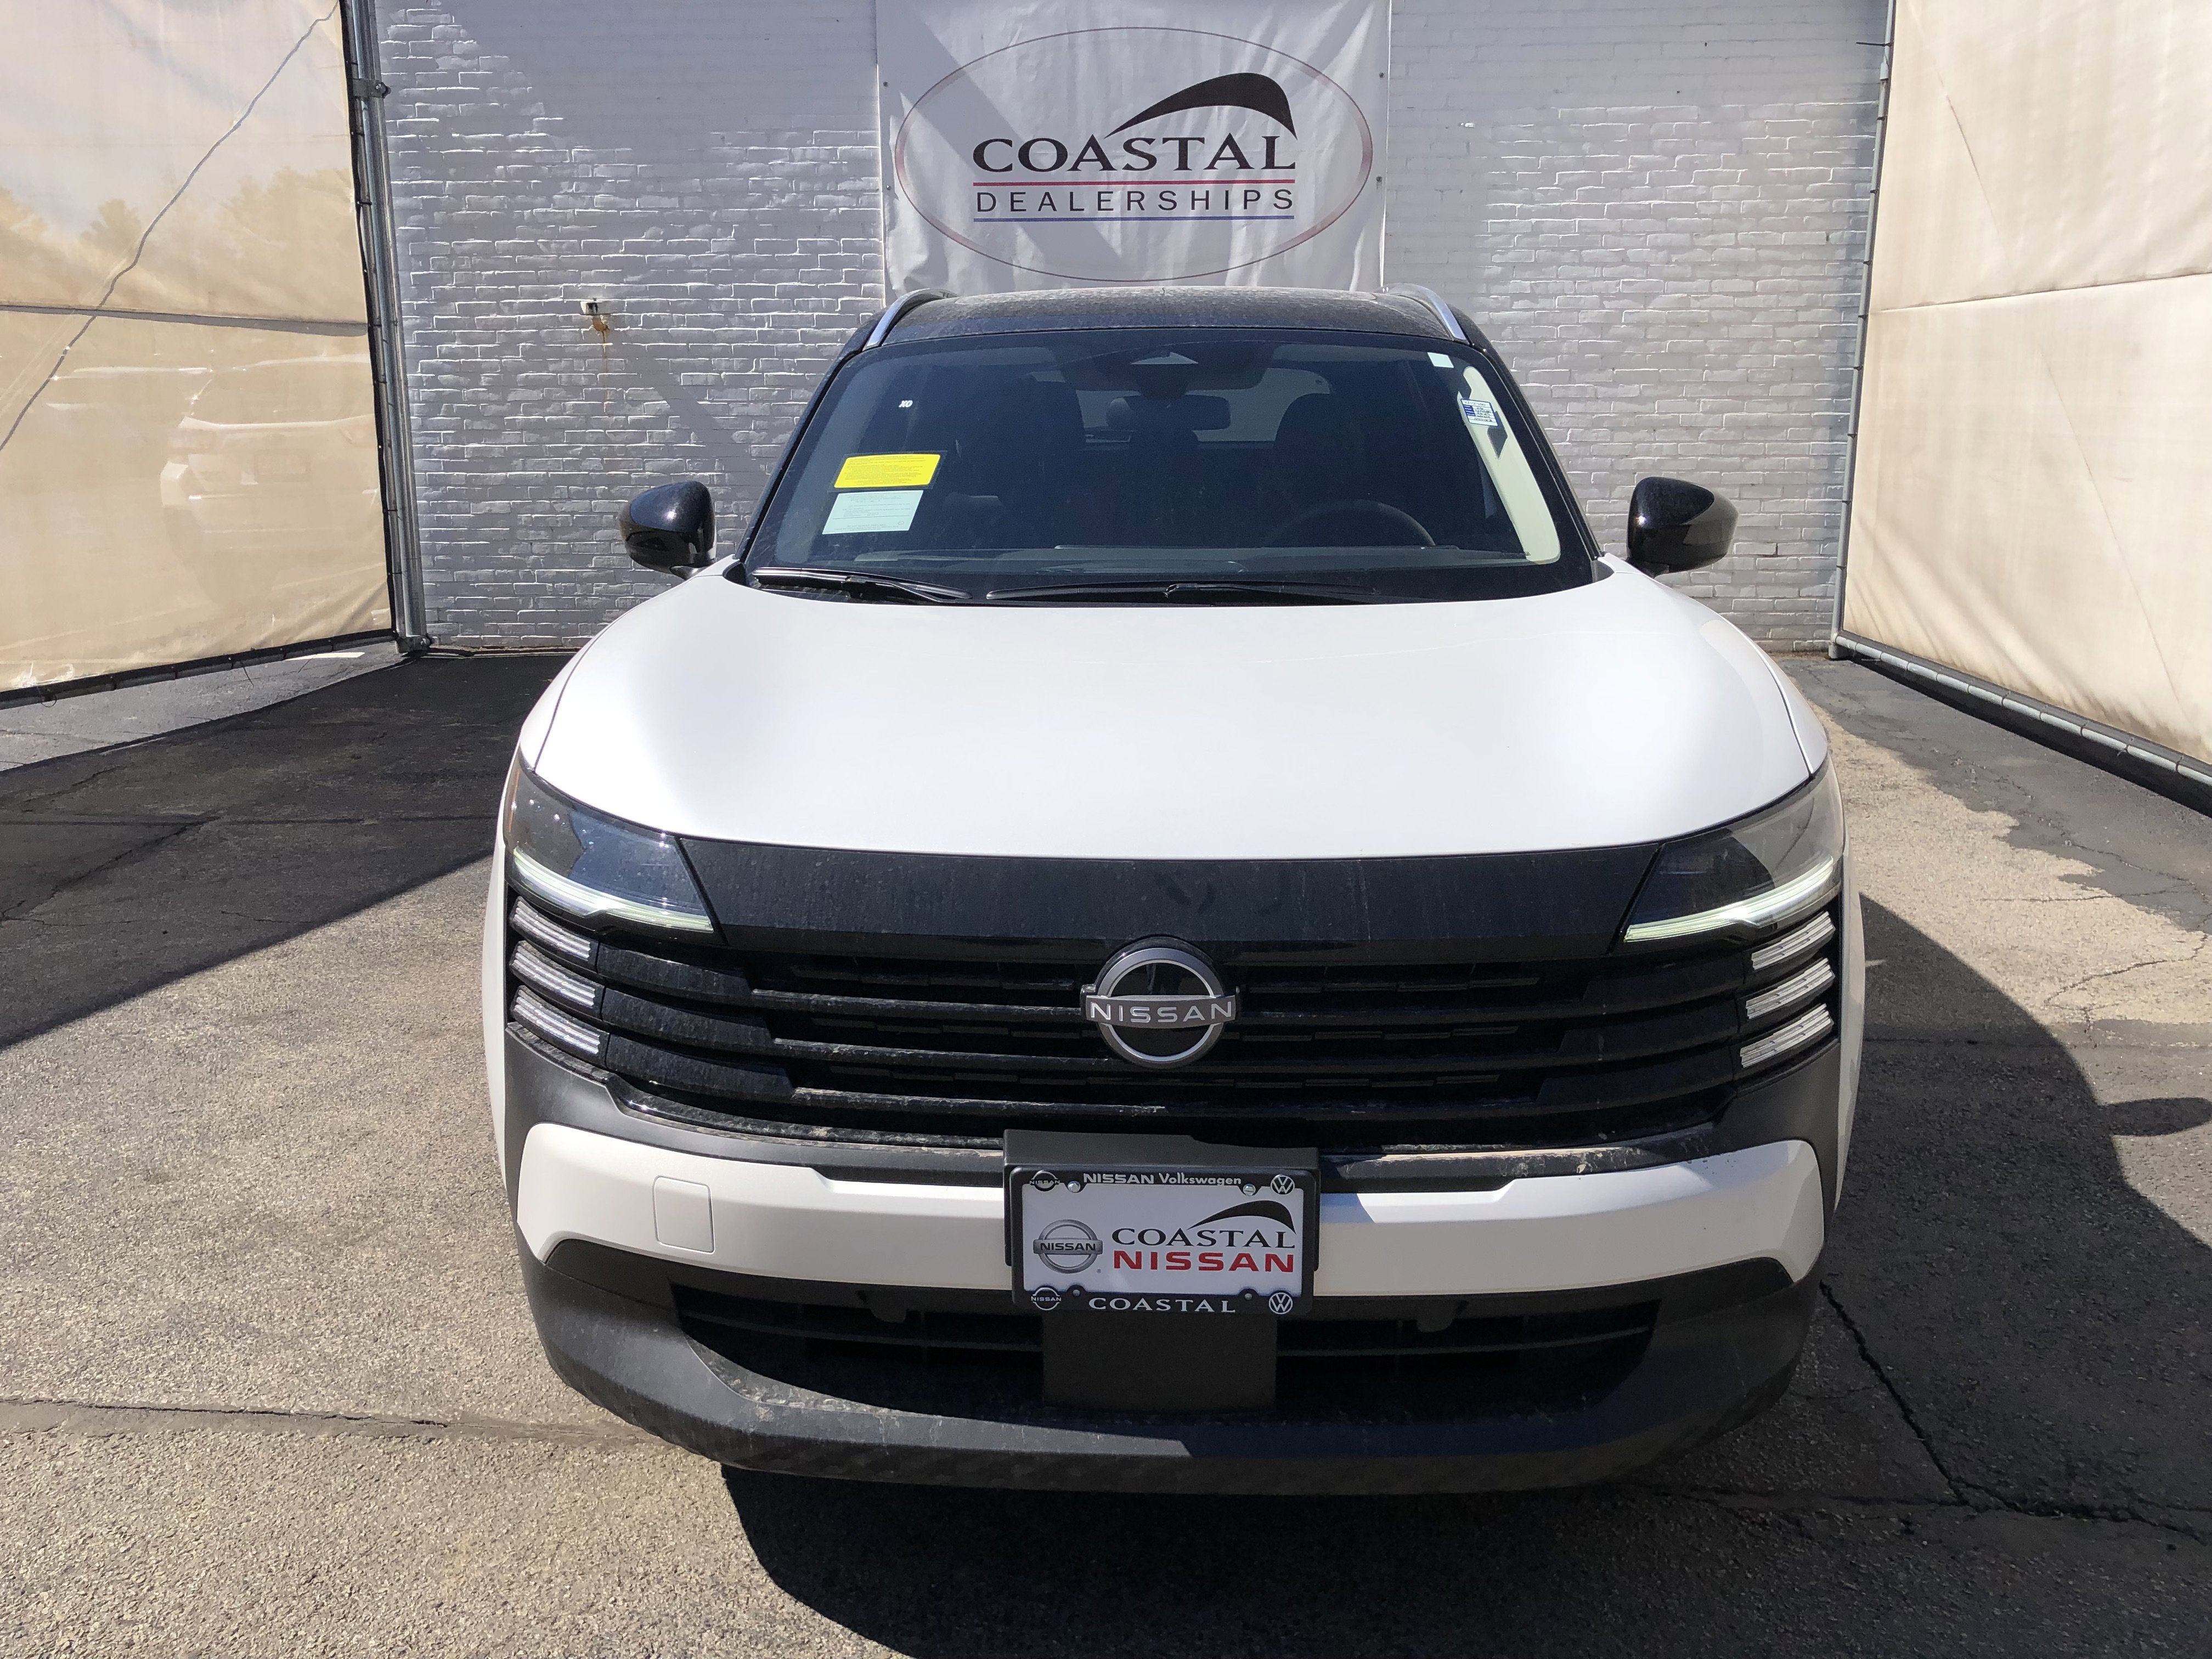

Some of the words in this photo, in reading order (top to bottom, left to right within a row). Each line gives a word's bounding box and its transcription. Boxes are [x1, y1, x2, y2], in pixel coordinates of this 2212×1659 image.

[973, 133, 1296, 172] COASTAL
[977, 189, 1294, 213] DEALERSHIPS
[1090, 1001, 1232, 1023] NISSAN
[1084, 1173, 1154, 1184] NISSAN
[1159, 1172, 1242, 1186] Volkswagen
[1040, 1242, 1096, 1251] NISSAN
[1111, 1228, 1295, 1248] COASTAL
[1113, 1250, 1294, 1273] NISSAN
[1088, 1297, 1235, 1313] COASTAL
